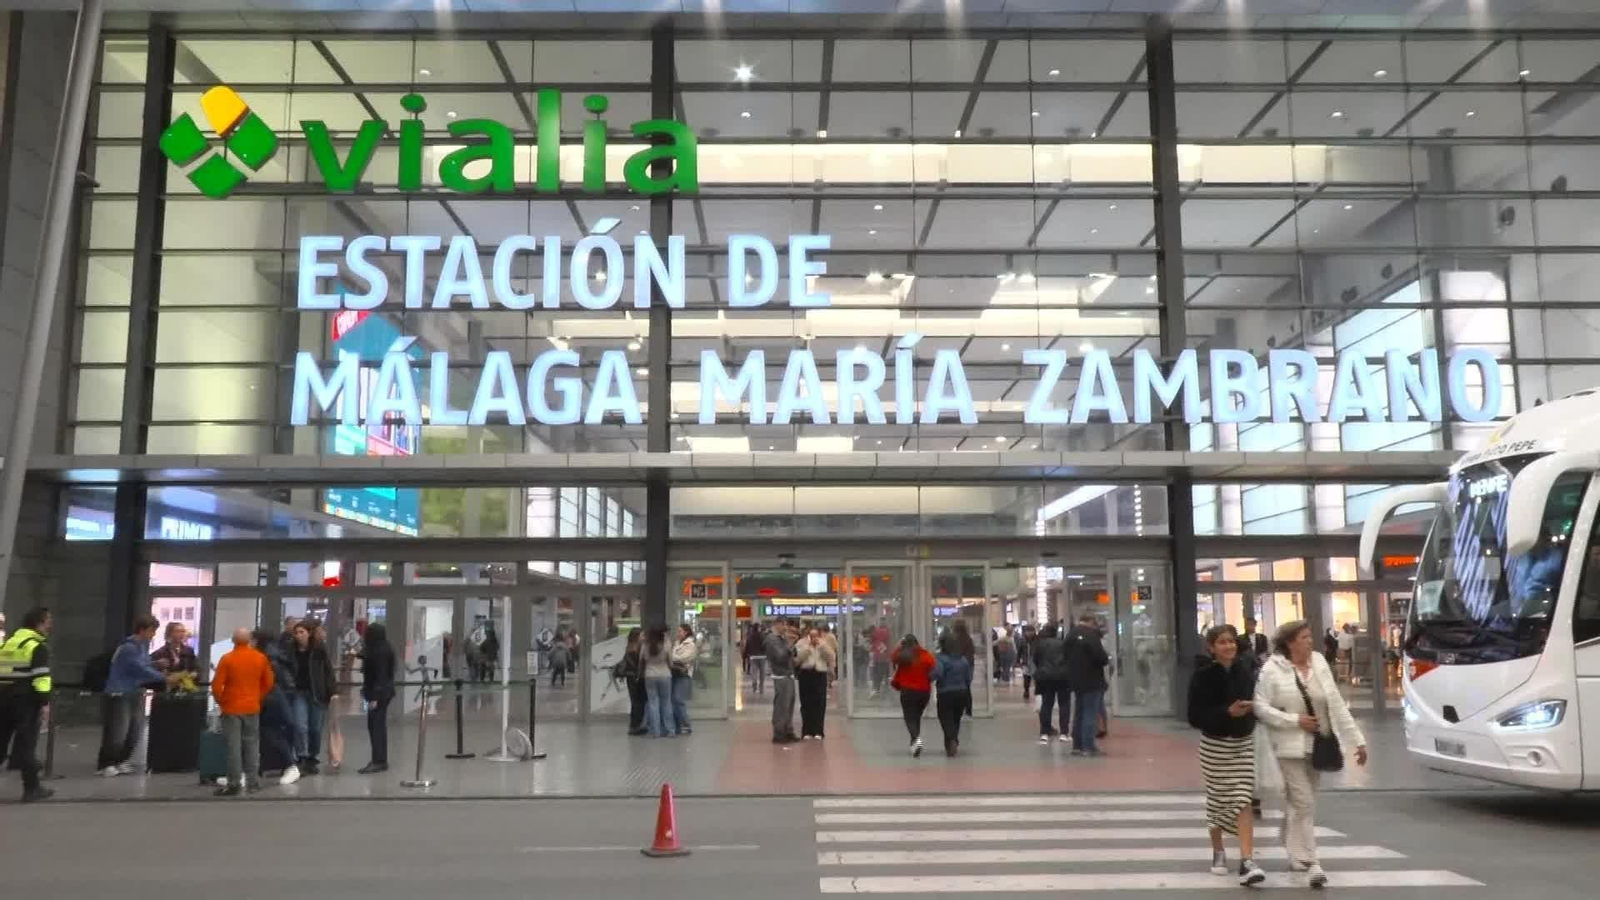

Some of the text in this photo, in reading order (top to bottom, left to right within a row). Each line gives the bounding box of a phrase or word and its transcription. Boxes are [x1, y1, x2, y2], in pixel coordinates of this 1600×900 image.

[300, 88, 698, 193] vialia
[297, 218, 832, 309] ESTACIÓN DE
[290, 333, 1502, 426] MÁLAGA MARÍA ZAMBRANO
[1508, 439, 1537, 452] PEPE
